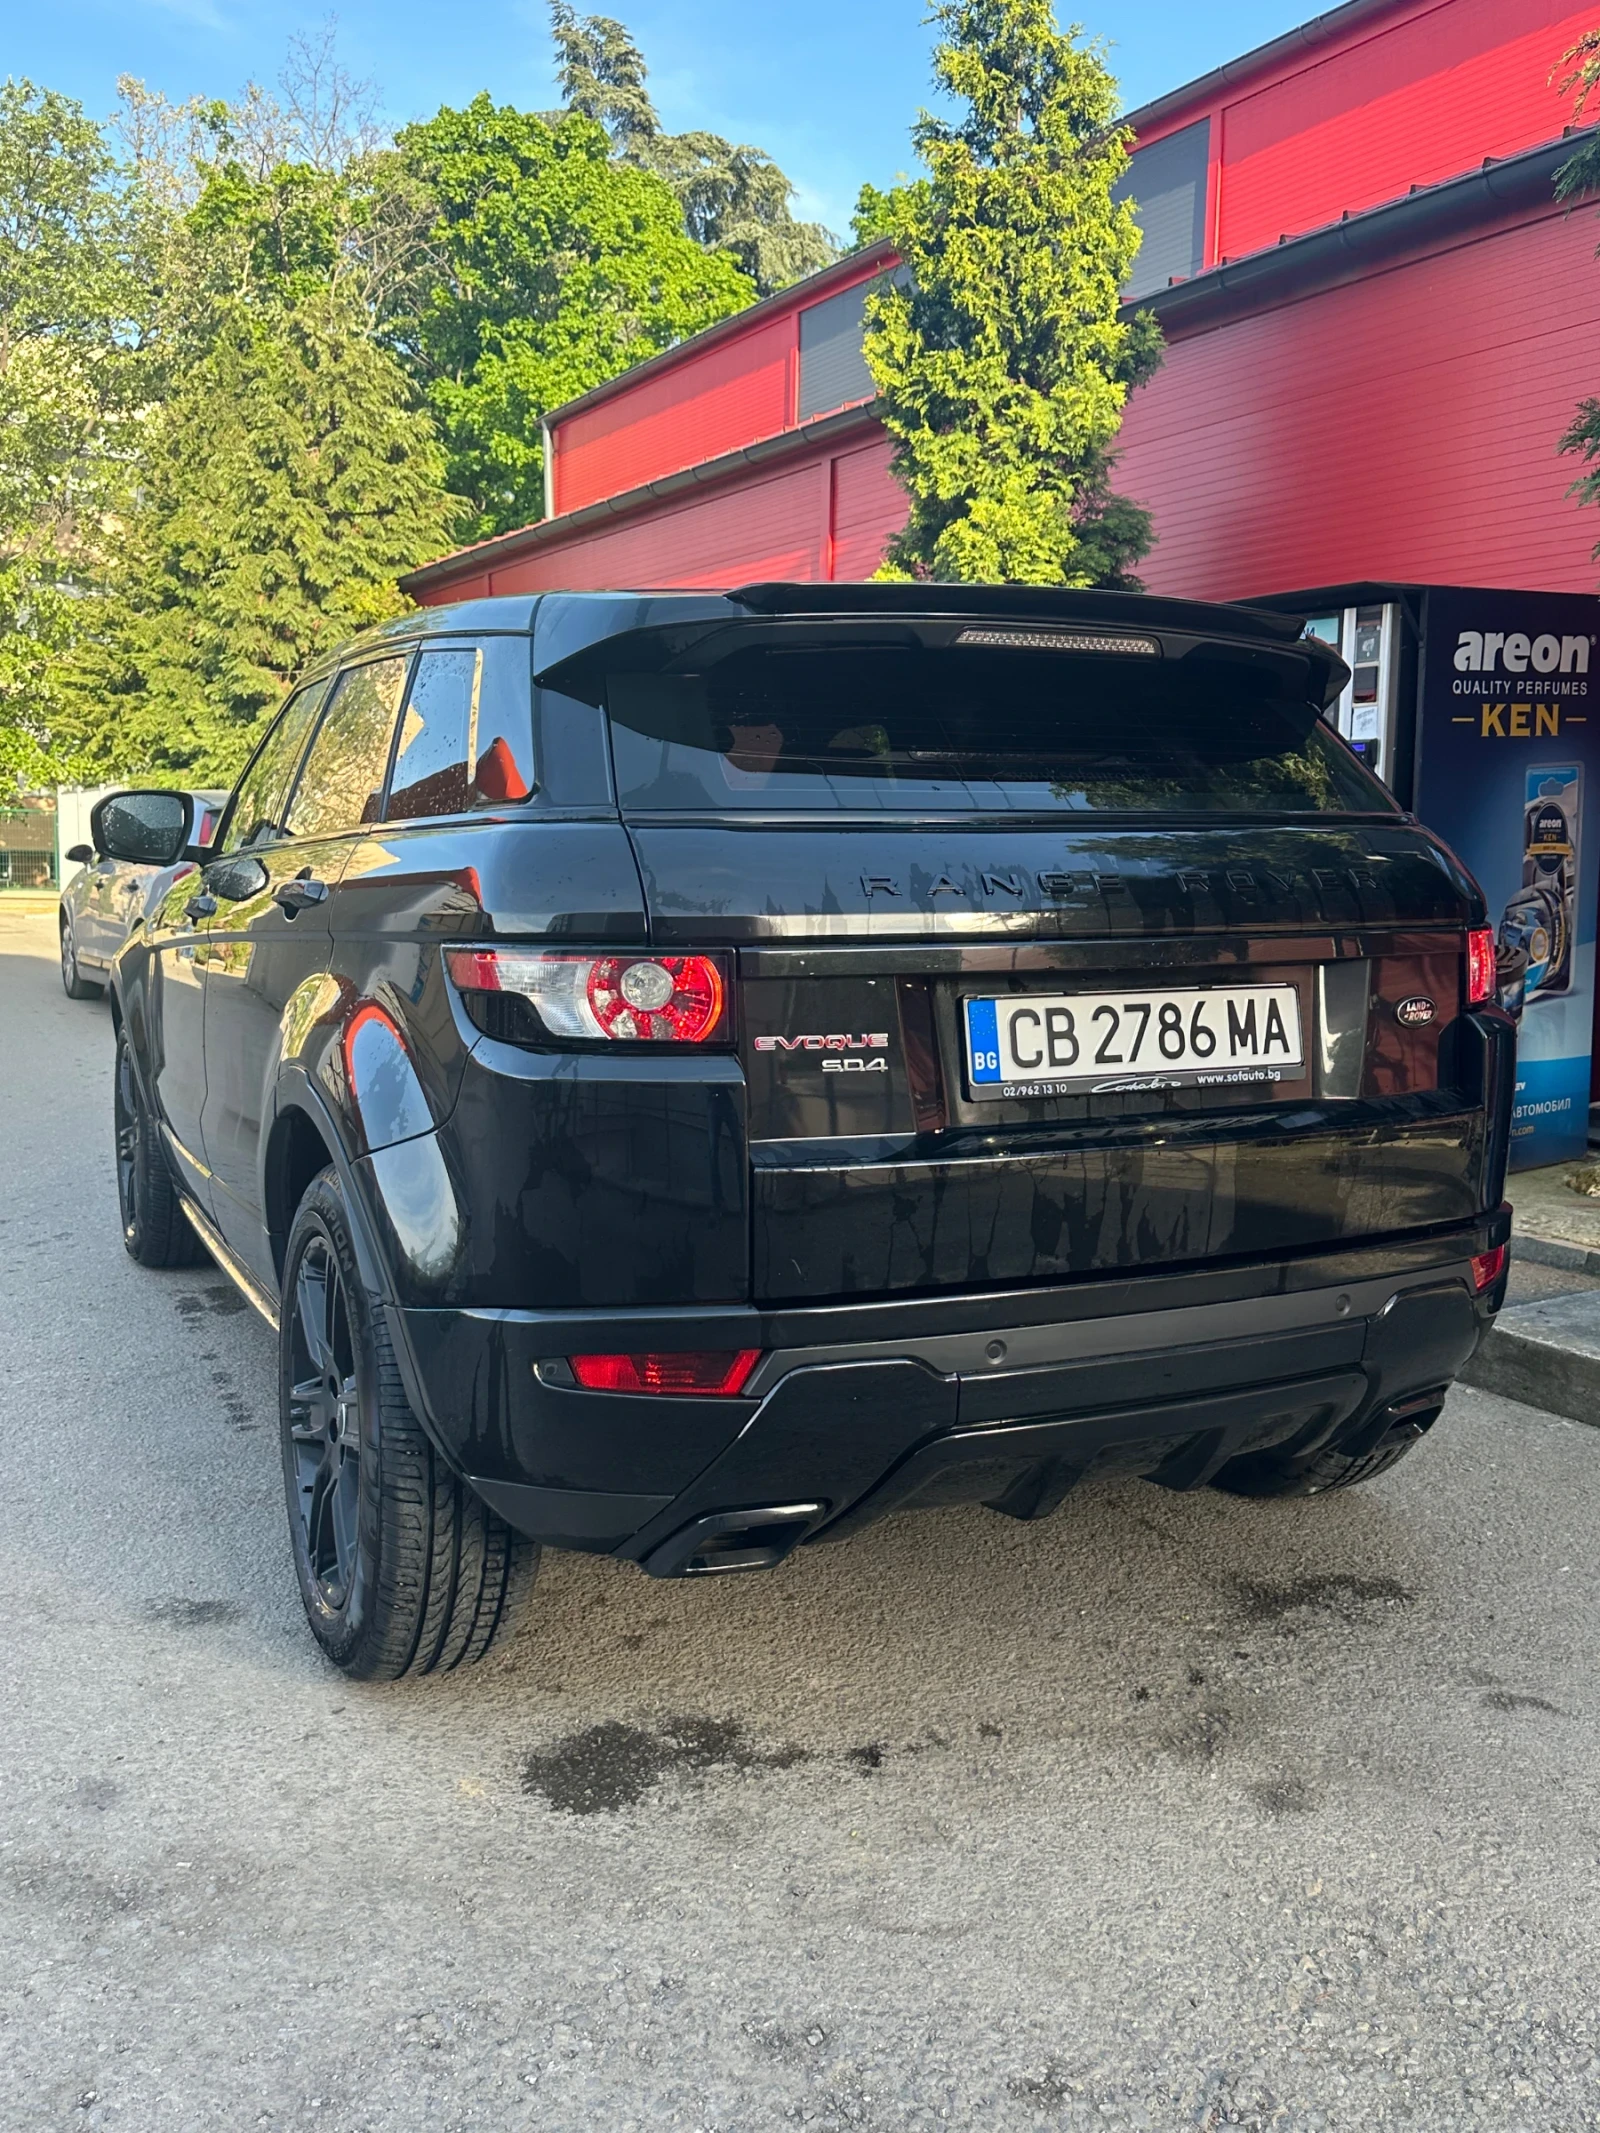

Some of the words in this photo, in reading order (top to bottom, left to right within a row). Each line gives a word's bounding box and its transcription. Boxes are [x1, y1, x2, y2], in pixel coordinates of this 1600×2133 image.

[1453, 631, 1590, 673] areon
[1452, 680, 1510, 695] QUALITY
[1516, 680, 1588, 696] PERFUMES
[1480, 703, 1560, 737] KEN
[860, 871, 1125, 899] RANGE
[1175, 868, 1377, 894] ROVER
[1406, 1001, 1427, 1012] LAND
[1408, 1010, 1433, 1021] ROVER
[754, 1033, 889, 1051] EVOQUE
[821, 1057, 889, 1073] SD4
[975, 1052, 998, 1071] BG
[1196, 1069, 1281, 1084] www.sofauto.bg
[1003, 1084, 1040, 1097] 02/962
[1511, 1125, 1535, 1137] n.com
